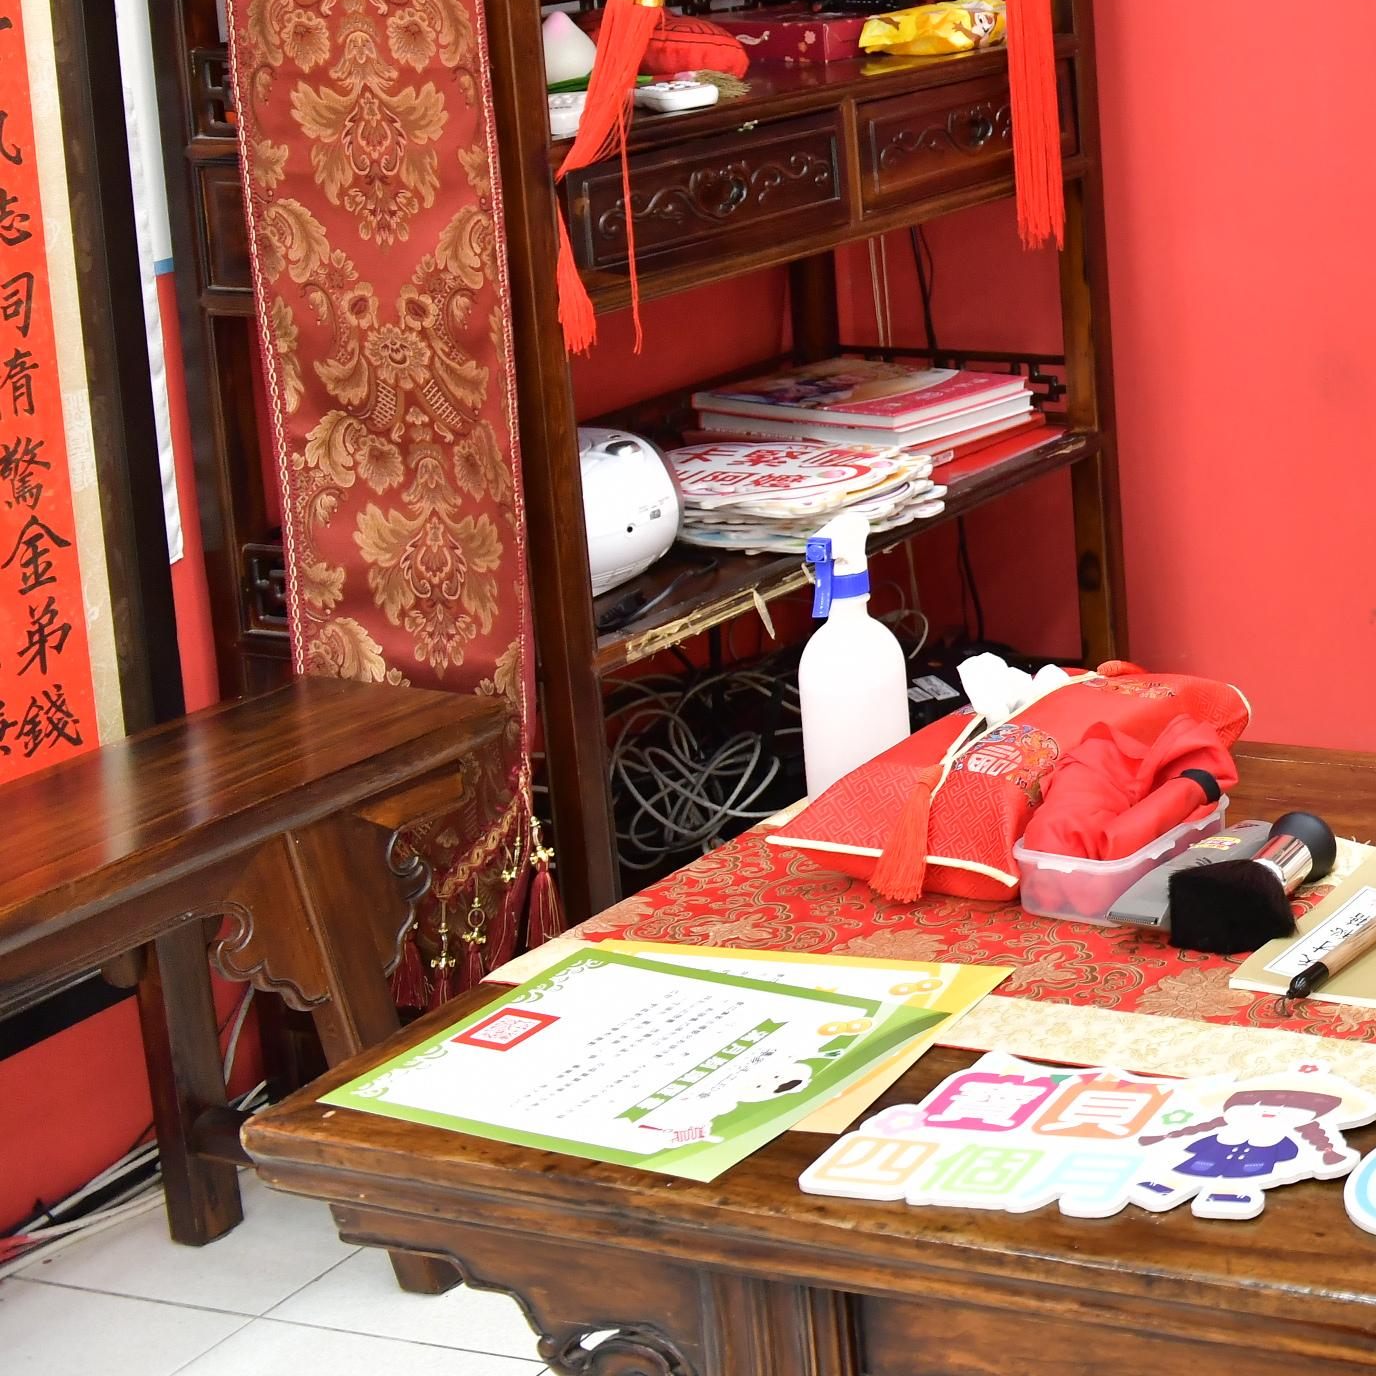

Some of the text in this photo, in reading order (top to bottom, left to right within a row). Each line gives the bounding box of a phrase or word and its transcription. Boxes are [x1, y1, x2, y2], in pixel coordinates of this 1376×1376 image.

[927, 1080, 1154, 1137] 寶貝
[812, 1134, 1149, 1202] 四個月
